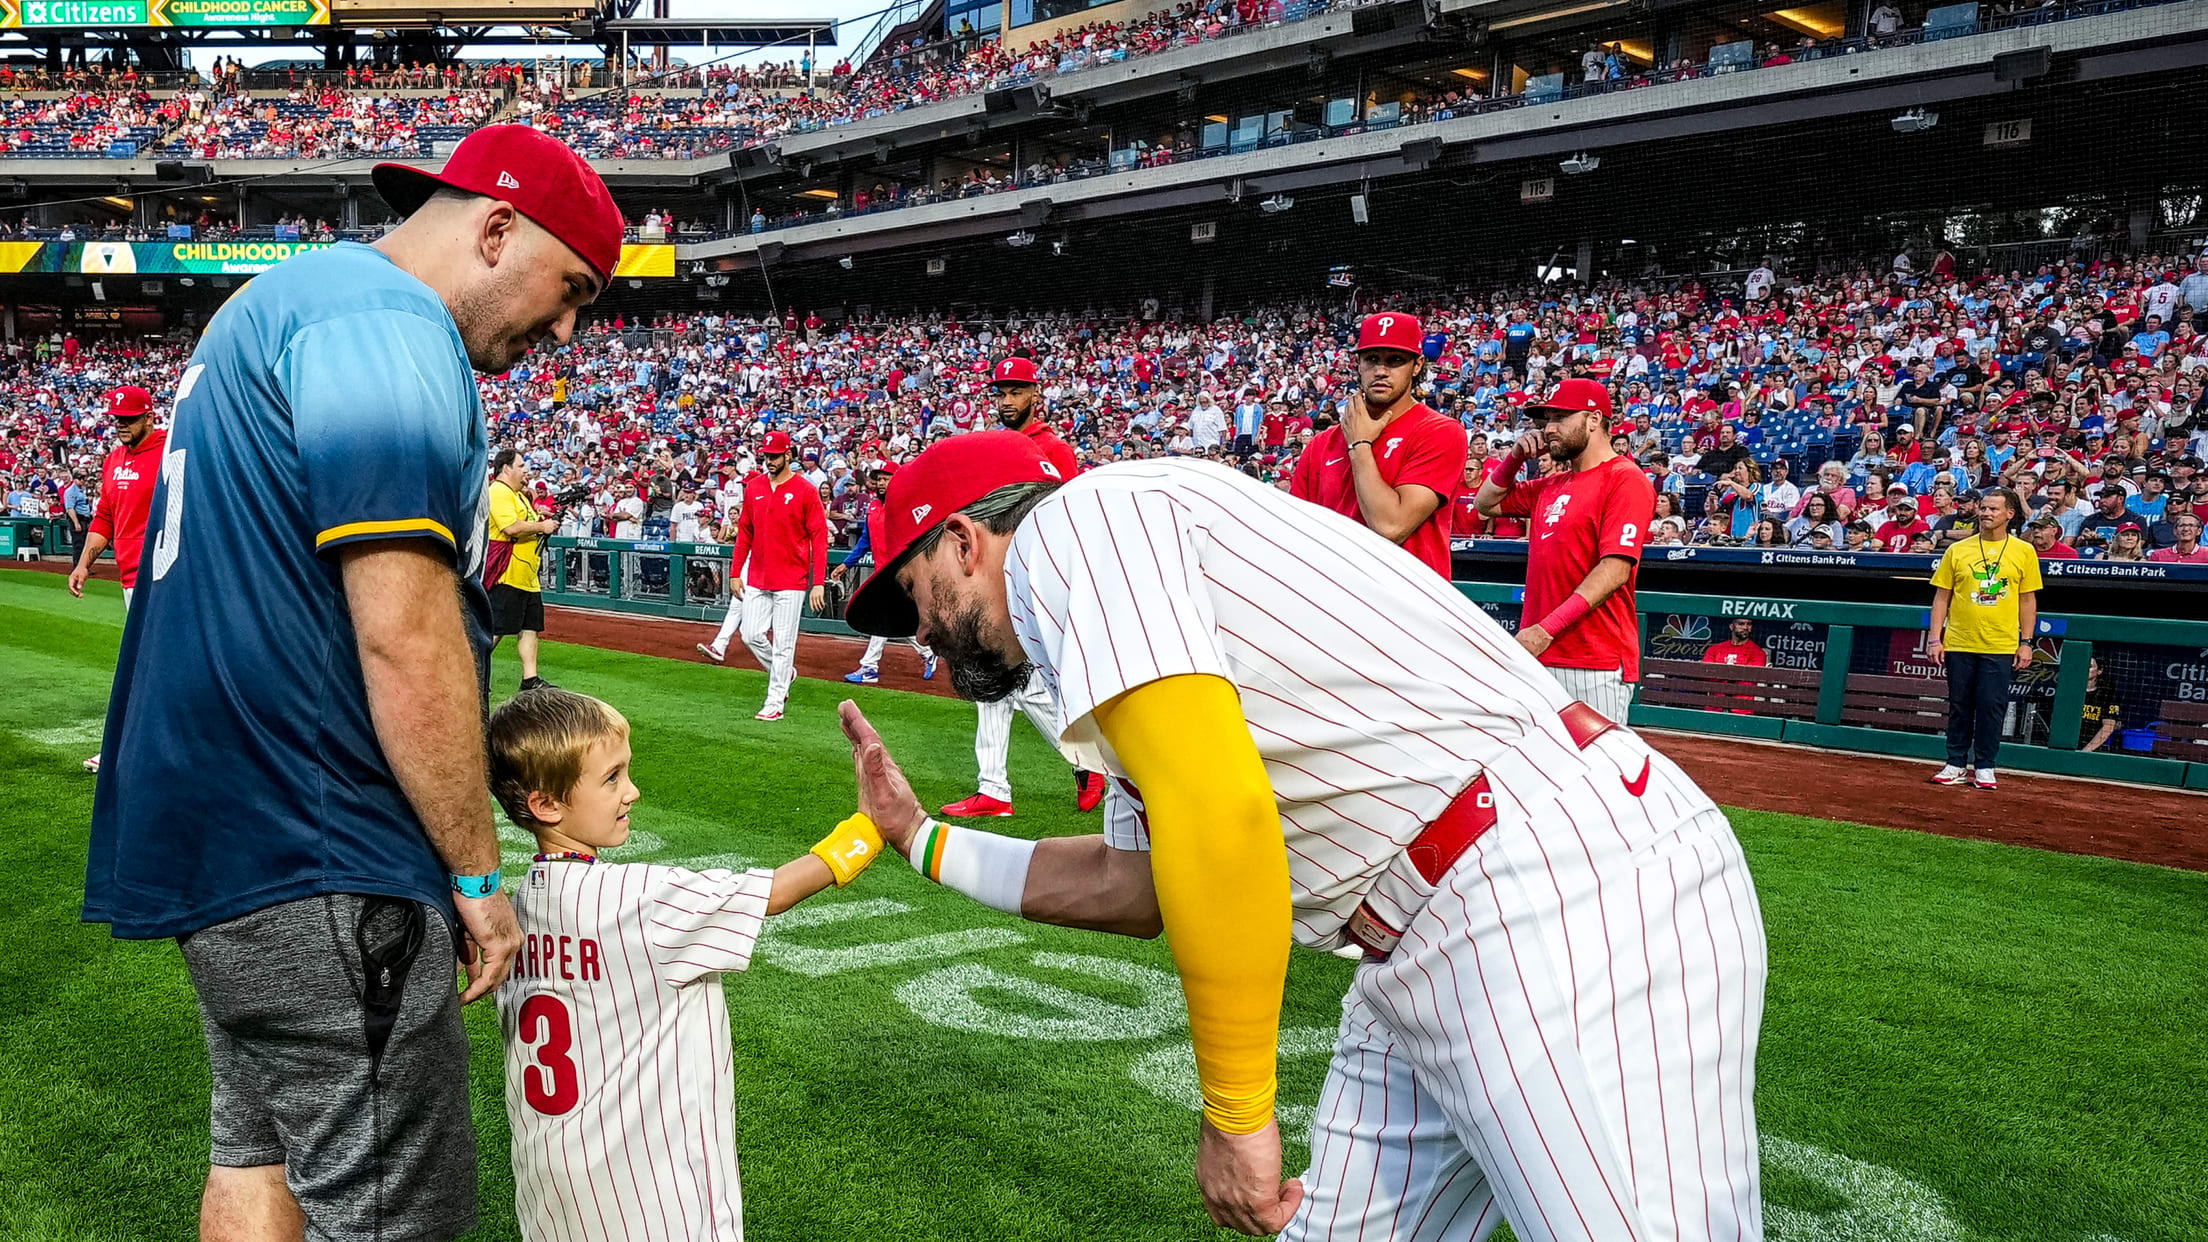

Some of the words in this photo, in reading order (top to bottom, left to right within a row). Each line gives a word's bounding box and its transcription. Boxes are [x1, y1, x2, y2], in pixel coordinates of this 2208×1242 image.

[52, 2, 137, 23] Citizens
[170, 1, 251, 13] CHILDHOOD
[253, 1, 308, 12] CANCER
[203, 13, 250, 22] Awareness
[251, 13, 275, 23] Night
[173, 243, 291, 261] CHILDHOOD
[1378, 317, 1394, 336] P
[1003, 361, 1014, 375] P
[115, 393, 125, 405] P
[113, 466, 140, 481] Phillies
[784, 492, 794, 504] P
[1620, 523, 1638, 547] 2
[695, 545, 721, 556] RE/MAX
[1776, 554, 1811, 564] Citizens
[1812, 555, 1834, 564] Bank
[1836, 556, 1856, 565] Park
[2066, 564, 2109, 575] Citizens
[2111, 566, 2139, 576] Bank
[2141, 567, 2166, 577] Park
[1722, 600, 1794, 619] RE/MAX
[1651, 634, 1709, 657] Sport
[1765, 634, 1825, 653] Citizen
[1775, 651, 1818, 669] Bank
[1893, 660, 1948, 680] Temple
[2166, 663, 2208, 682] Citi
[2178, 682, 2208, 700] Ba
[845, 838, 868, 858] P
[1361, 923, 1386, 945] 12
[508, 934, 601, 982] ARPER
[518, 994, 579, 1116] 3
